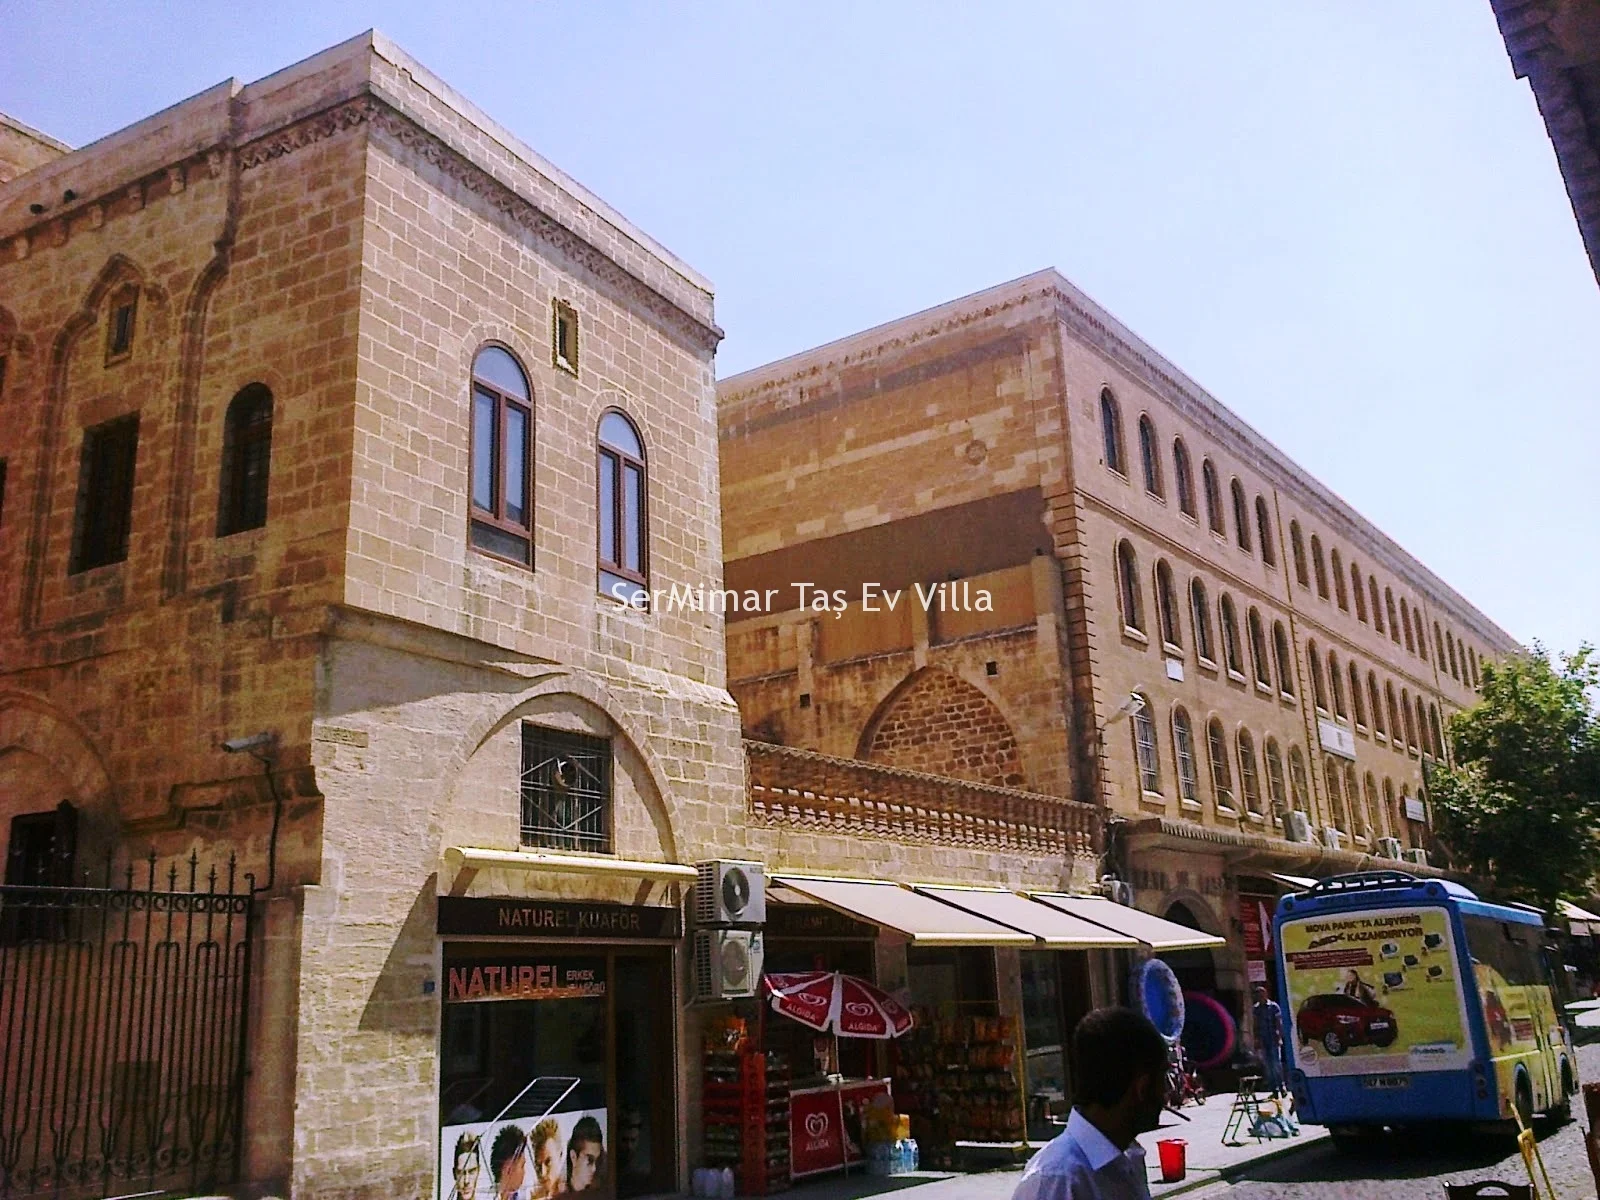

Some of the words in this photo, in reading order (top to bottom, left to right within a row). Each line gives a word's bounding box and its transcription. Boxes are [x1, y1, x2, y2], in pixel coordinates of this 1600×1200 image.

[499, 907, 576, 928] NATUREL
[579, 908, 640, 930] KUAFÖR
[1347, 927, 1424, 942] KAZANDIRIYOR
[448, 964, 561, 1000] NATUREL
[566, 969, 595, 981] ERKEK
[785, 1003, 816, 1020] ALGIDA
[848, 1021, 878, 1032] ALGIDA
